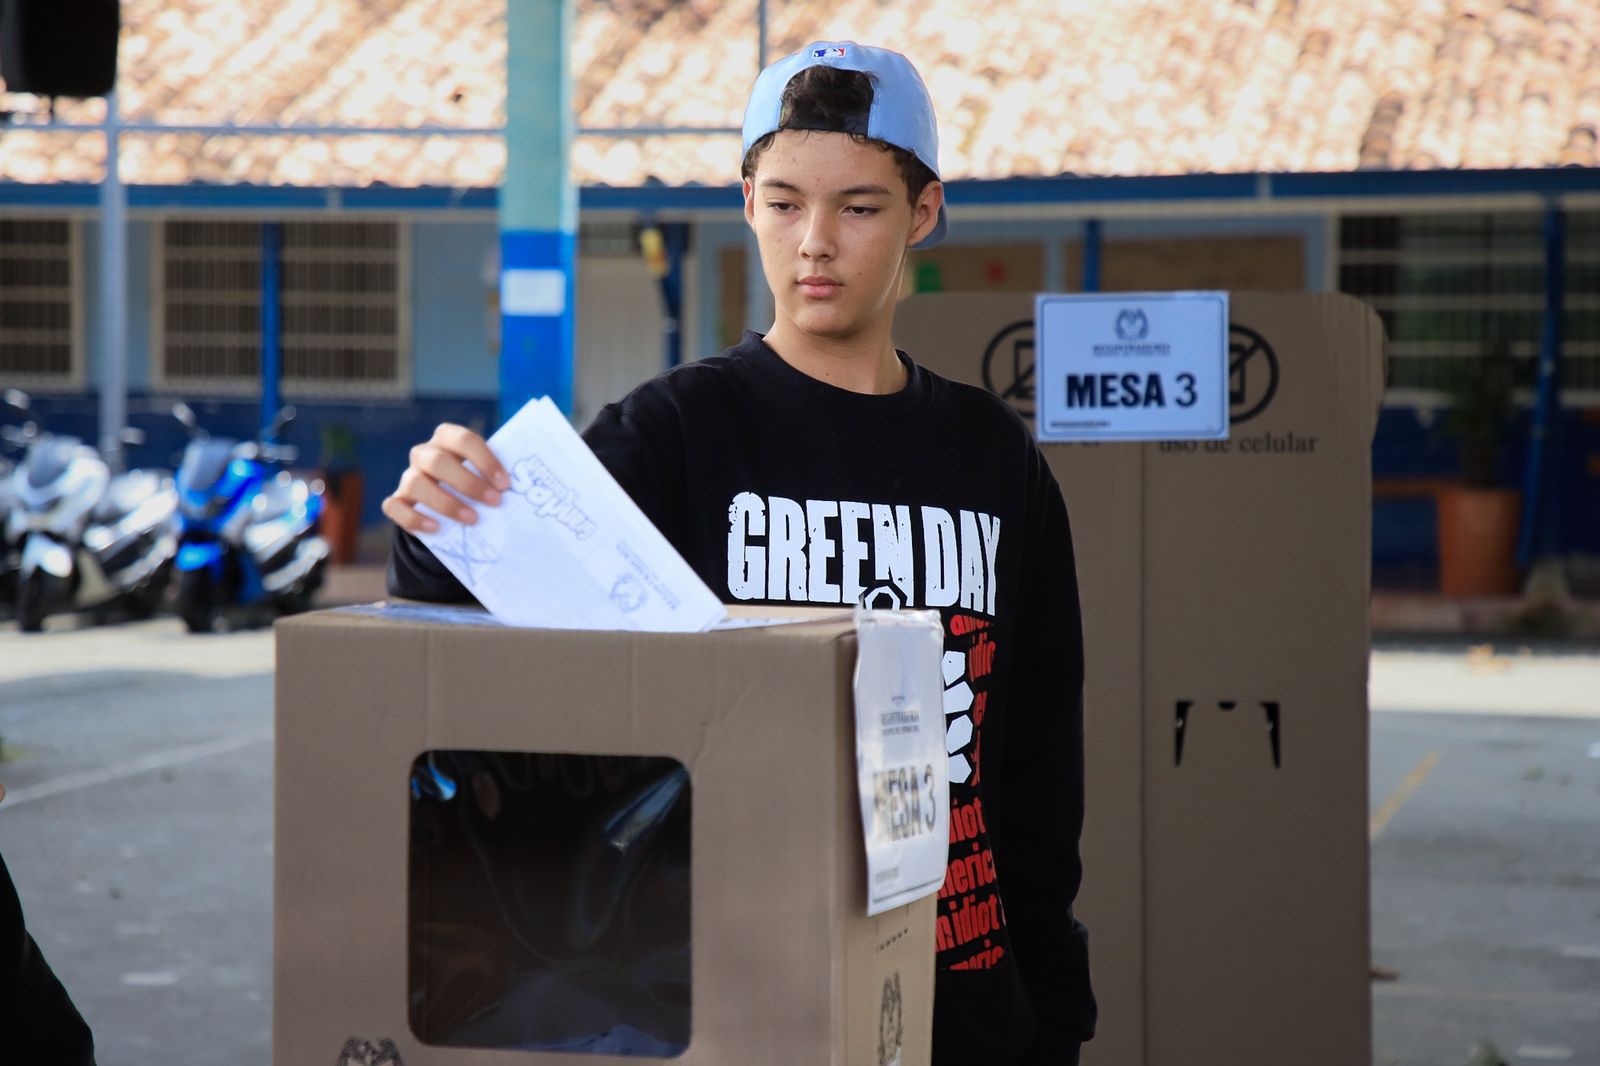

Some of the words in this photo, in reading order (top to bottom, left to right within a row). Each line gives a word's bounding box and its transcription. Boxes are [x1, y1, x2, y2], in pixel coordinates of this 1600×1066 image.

[1066, 373, 1166, 409] MESA
[1175, 373, 1199, 409] 3
[1239, 430, 1318, 454] celular
[727, 491, 914, 607] GREEN
[920, 505, 1001, 616] DAY
[924, 764, 937, 833] 3
[949, 894, 1000, 946] idiot
